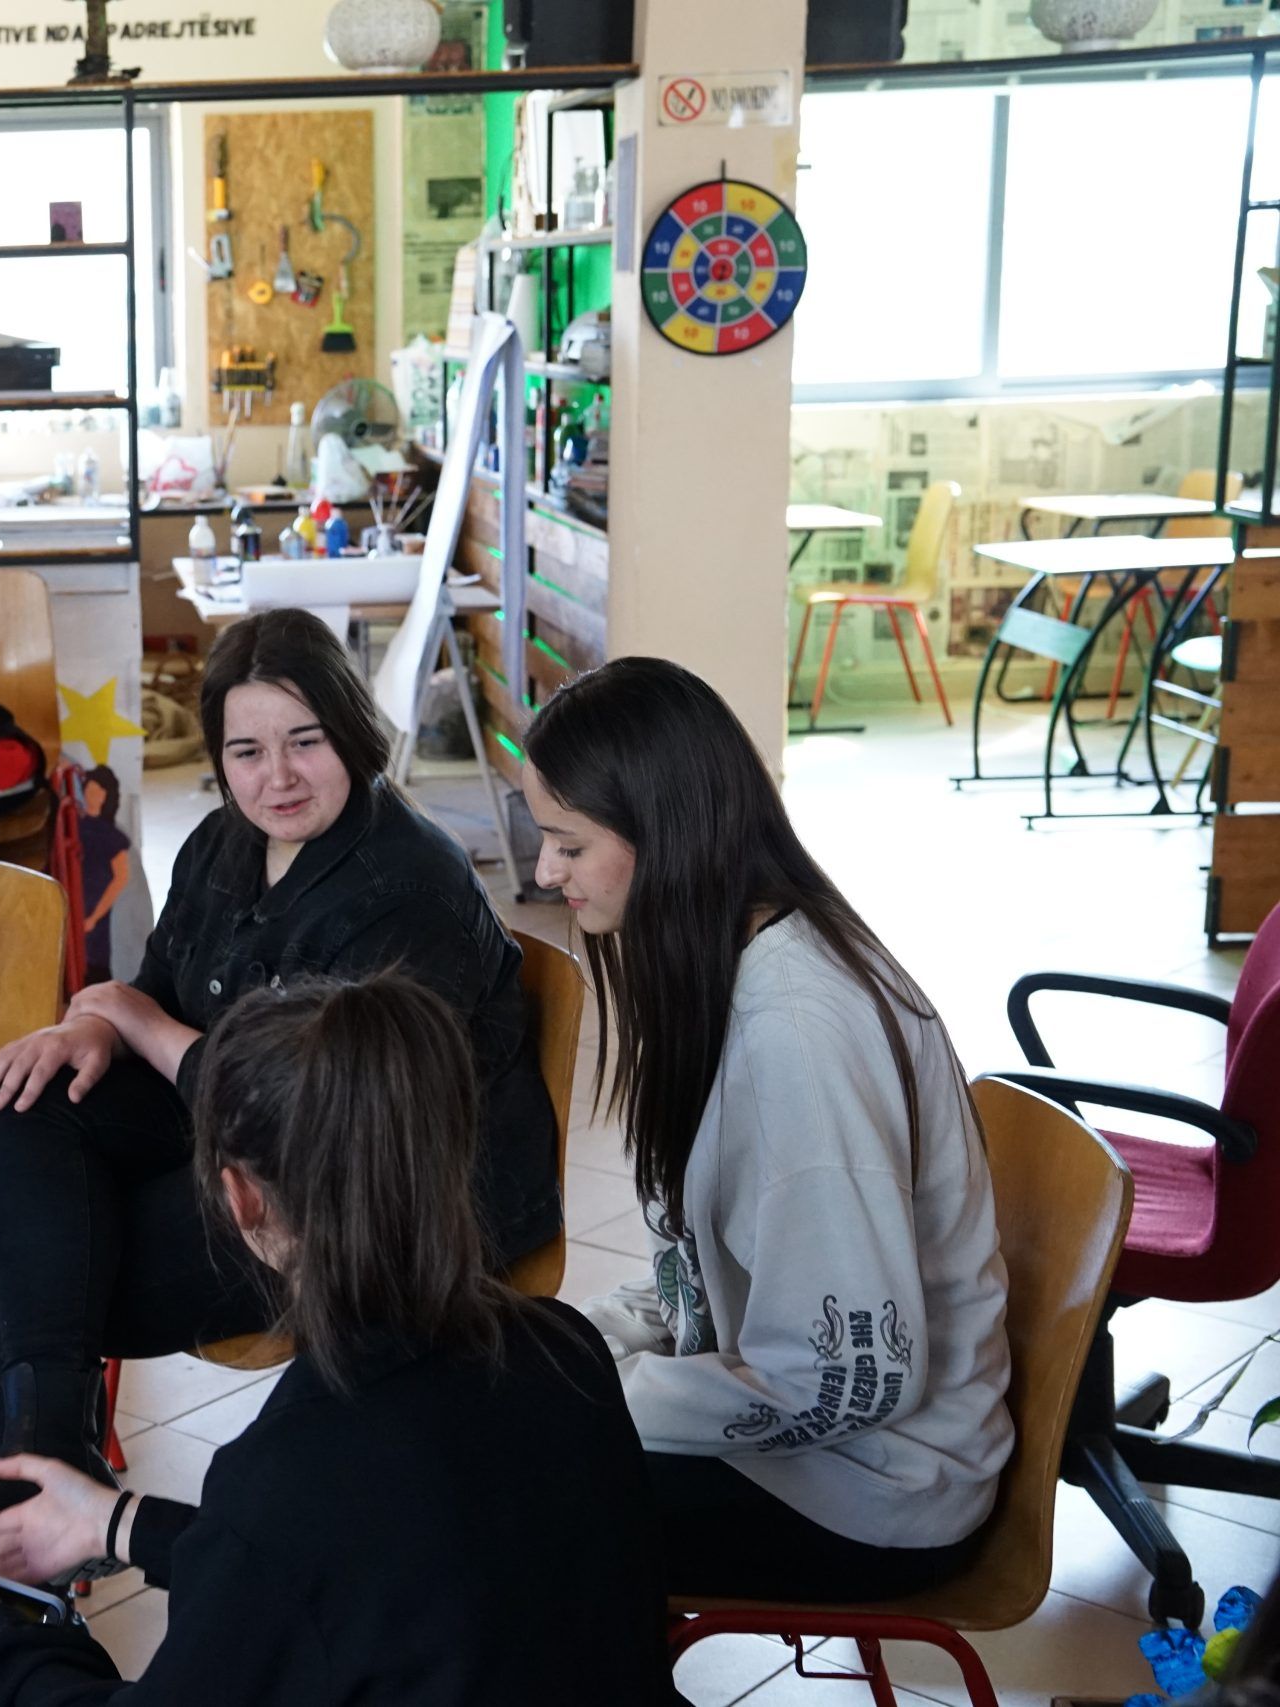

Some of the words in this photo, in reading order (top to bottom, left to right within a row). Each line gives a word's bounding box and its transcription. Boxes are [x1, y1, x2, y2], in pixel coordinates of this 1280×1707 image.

[45, 25, 87, 42] NDA
[729, 85, 779, 111] SMOKIN
[654, 241, 670, 254] 10
[780, 240, 796, 253] 10
[652, 290, 668, 303] 10
[776, 289, 794, 302] 10
[849, 1310, 874, 1350] THE
[848, 1354, 878, 1413] GREAT
